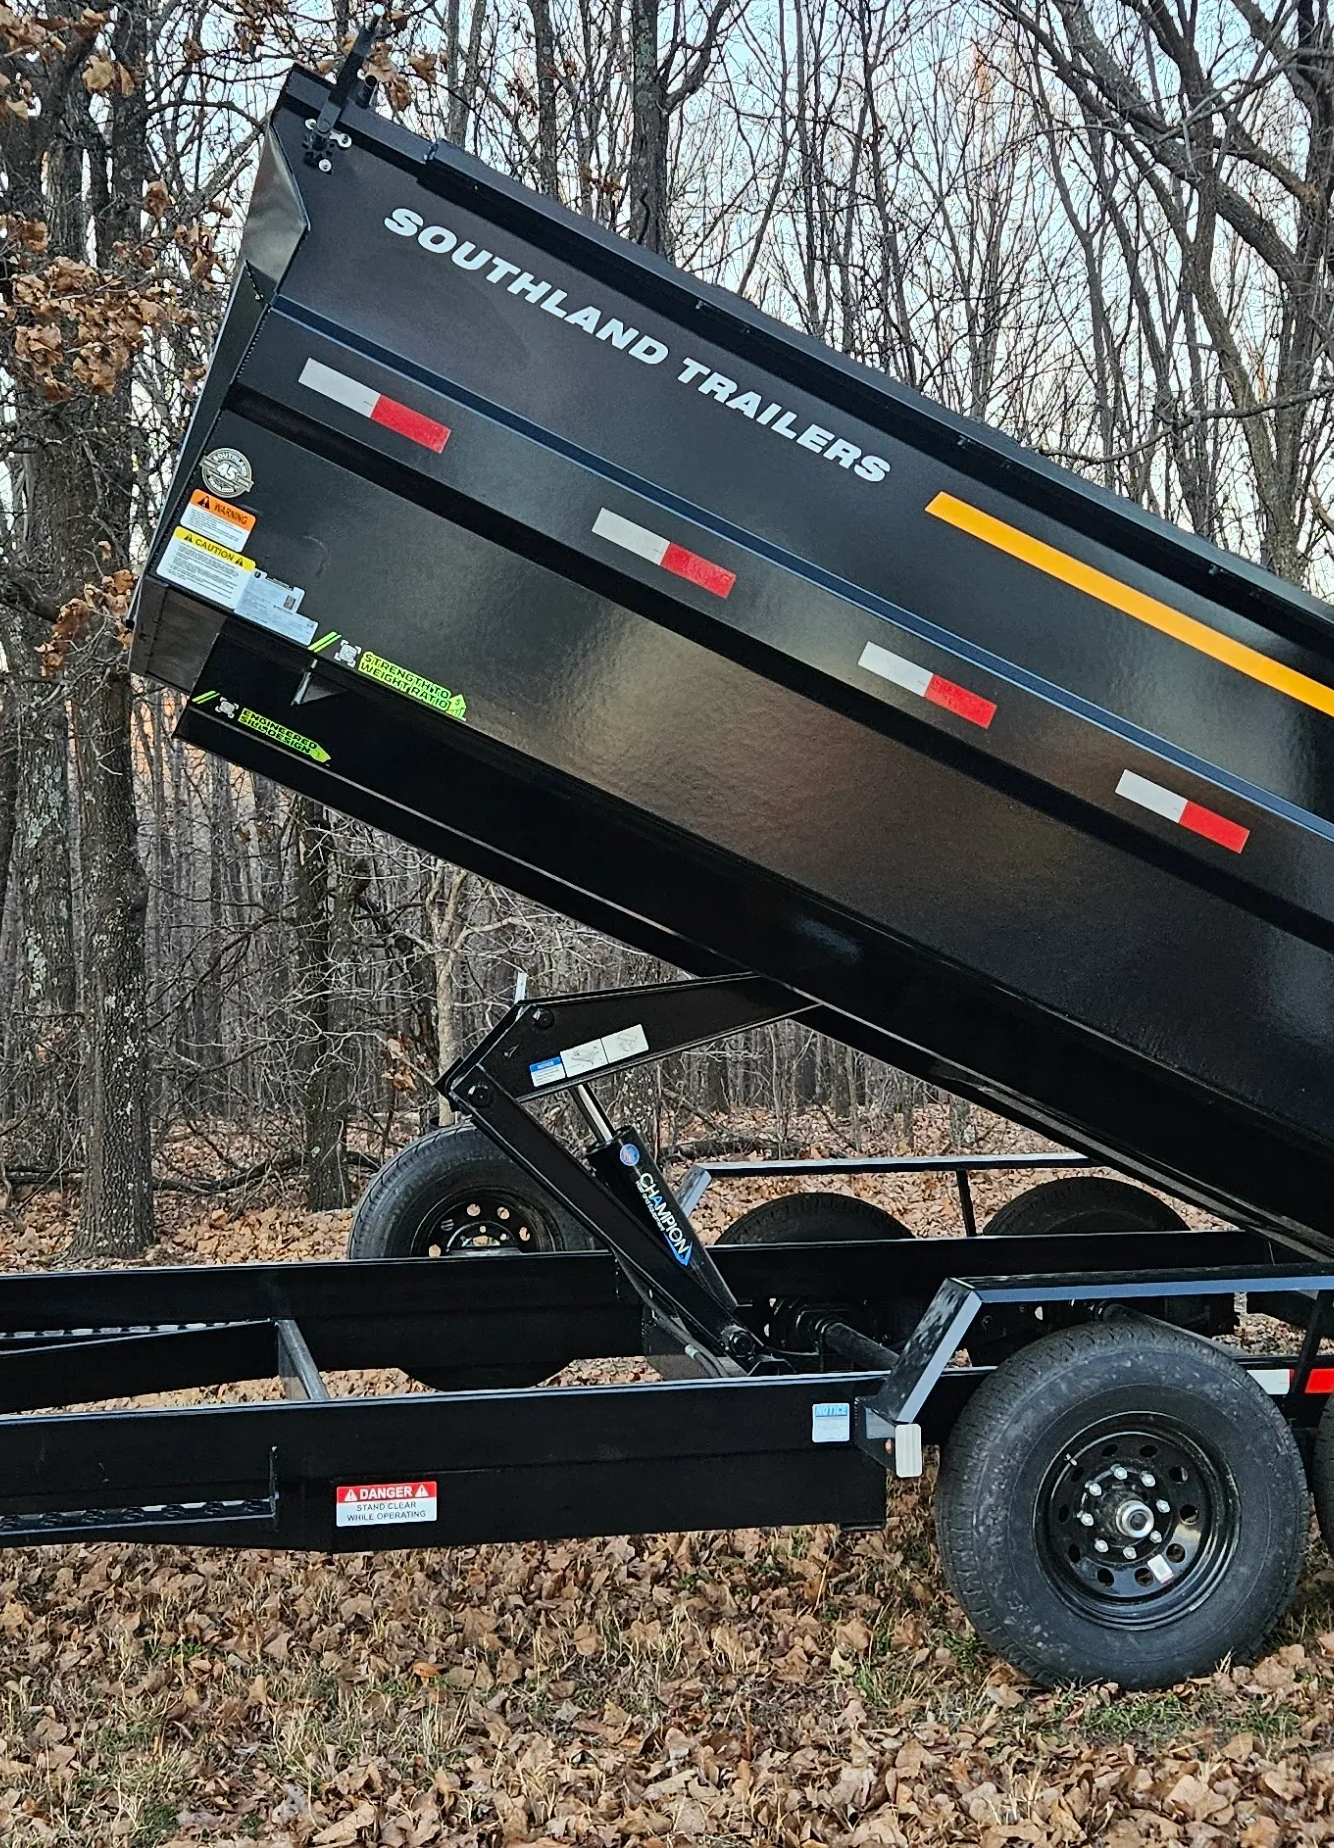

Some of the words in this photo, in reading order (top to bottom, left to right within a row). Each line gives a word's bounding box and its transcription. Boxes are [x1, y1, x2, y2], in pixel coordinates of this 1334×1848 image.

[384, 207, 669, 365] SOUTHLAND
[677, 357, 891, 482] TRAILERS
[216, 463, 238, 481] 45
[214, 502, 248, 525] WARNING
[195, 538, 235, 561] CAUTION
[361, 662, 409, 690] WEIGHT
[411, 686, 448, 709] RATIO
[365, 653, 431, 690] STRENGTH
[433, 685, 450, 700] TO
[243, 709, 317, 750] ENGINEERED
[267, 728, 311, 754] DESIGN
[639, 1172, 690, 1255] CHAMPION
[815, 1405, 847, 1416] NOTICE
[359, 1486, 413, 1500] DANGER
[347, 1513, 374, 1522] WHILE
[377, 1510, 426, 1520] OPERATING
[356, 1503, 385, 1512] STAND
[387, 1501, 416, 1510] CLEAR
